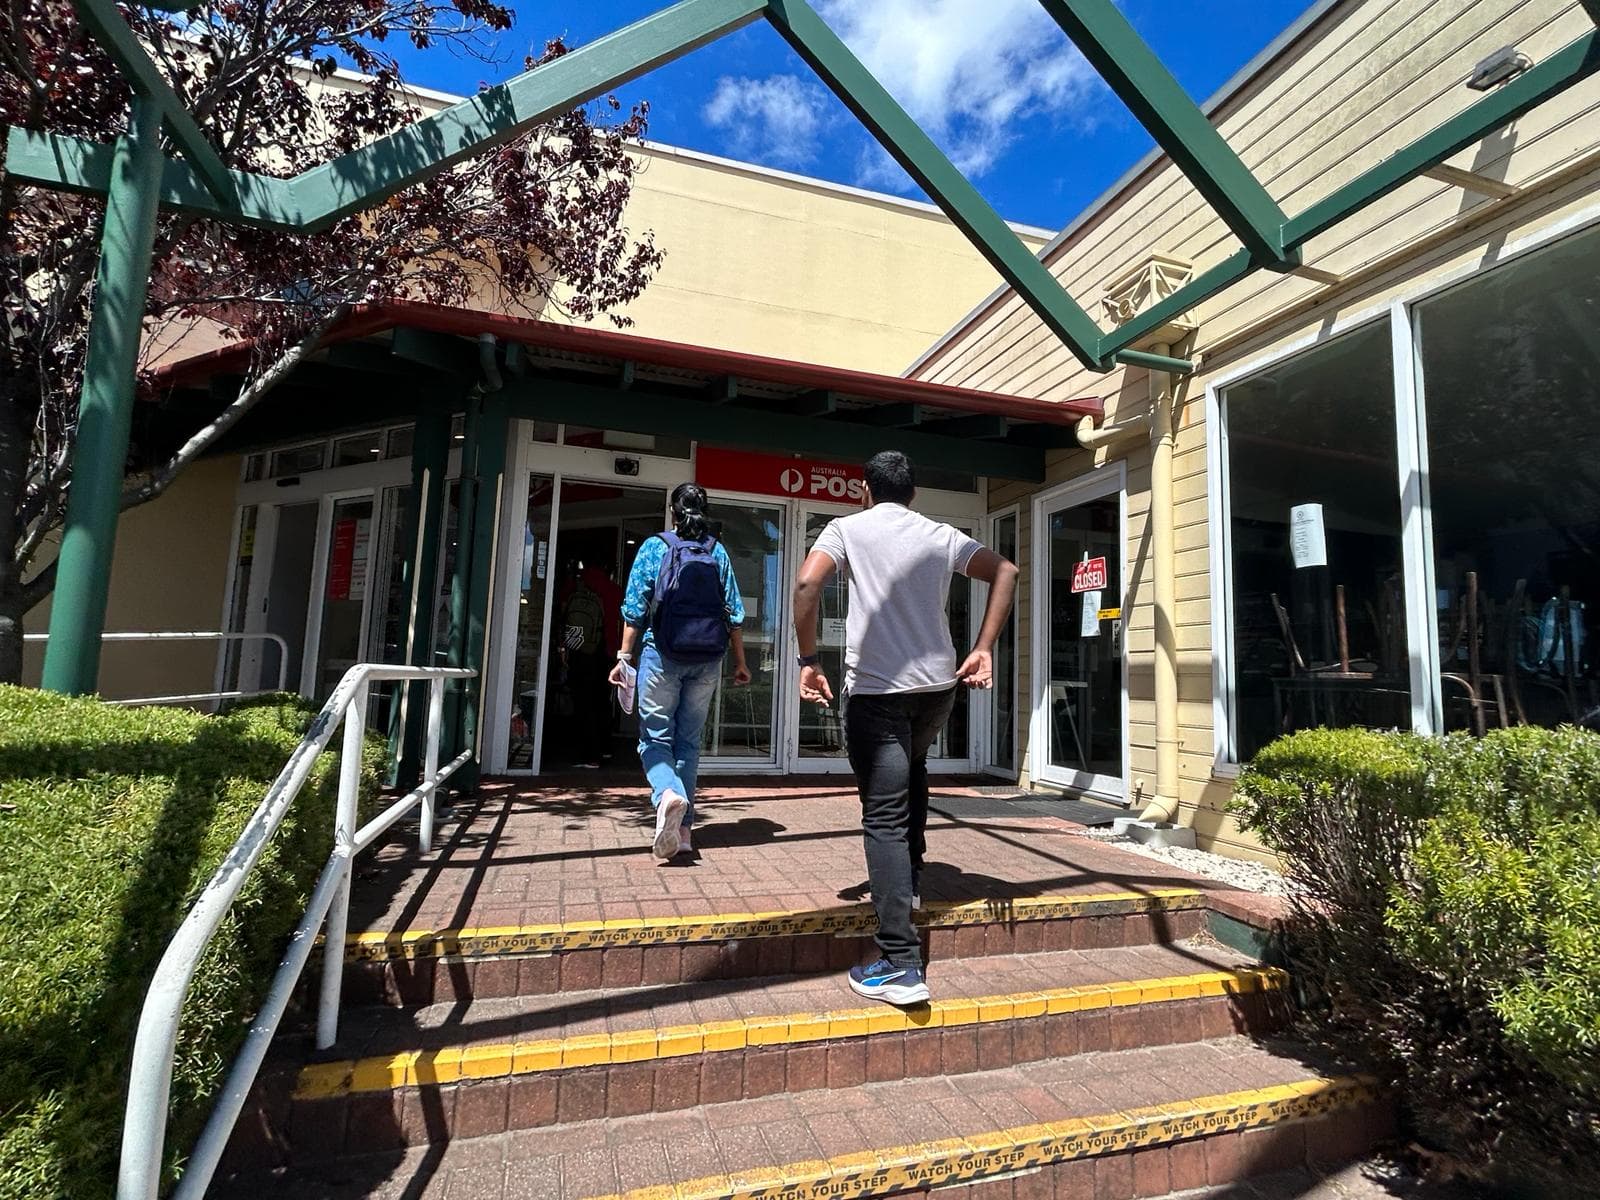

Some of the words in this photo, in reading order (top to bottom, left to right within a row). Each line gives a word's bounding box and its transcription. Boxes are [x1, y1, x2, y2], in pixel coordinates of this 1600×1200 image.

[811, 466, 846, 477] AUSTRALIA
[811, 474, 862, 499] POS
[1074, 570, 1103, 590] CLOSED
[957, 912, 981, 921] YOUR
[1016, 908, 1046, 916] WATCH
[1047, 905, 1070, 914] YOUR
[711, 925, 747, 935] WATCH
[750, 923, 779, 933] YOUR
[781, 921, 807, 931] STEP
[822, 919, 856, 929] WATCH
[858, 917, 879, 927] YOU
[457, 939, 499, 951] WATCH
[502, 937, 537, 948] YOUR
[540, 935, 571, 946] STEP
[588, 931, 628, 943] WATCH
[630, 929, 664, 940] YOUR
[666, 927, 694, 938] STEP
[1163, 1120, 1200, 1135] WATCH
[1201, 1115, 1231, 1129] YOUR
[1232, 1110, 1258, 1123] STEP
[1043, 1140, 1084, 1156] WATCH
[1086, 1134, 1118, 1150] YOUR
[1120, 1129, 1149, 1144] STEP
[908, 1164, 953, 1181] WATCH
[956, 1157, 991, 1173] YOUR
[994, 1151, 1025, 1165] STEP
[811, 1182, 849, 1198] YOUR
[853, 1175, 888, 1191] STEP
